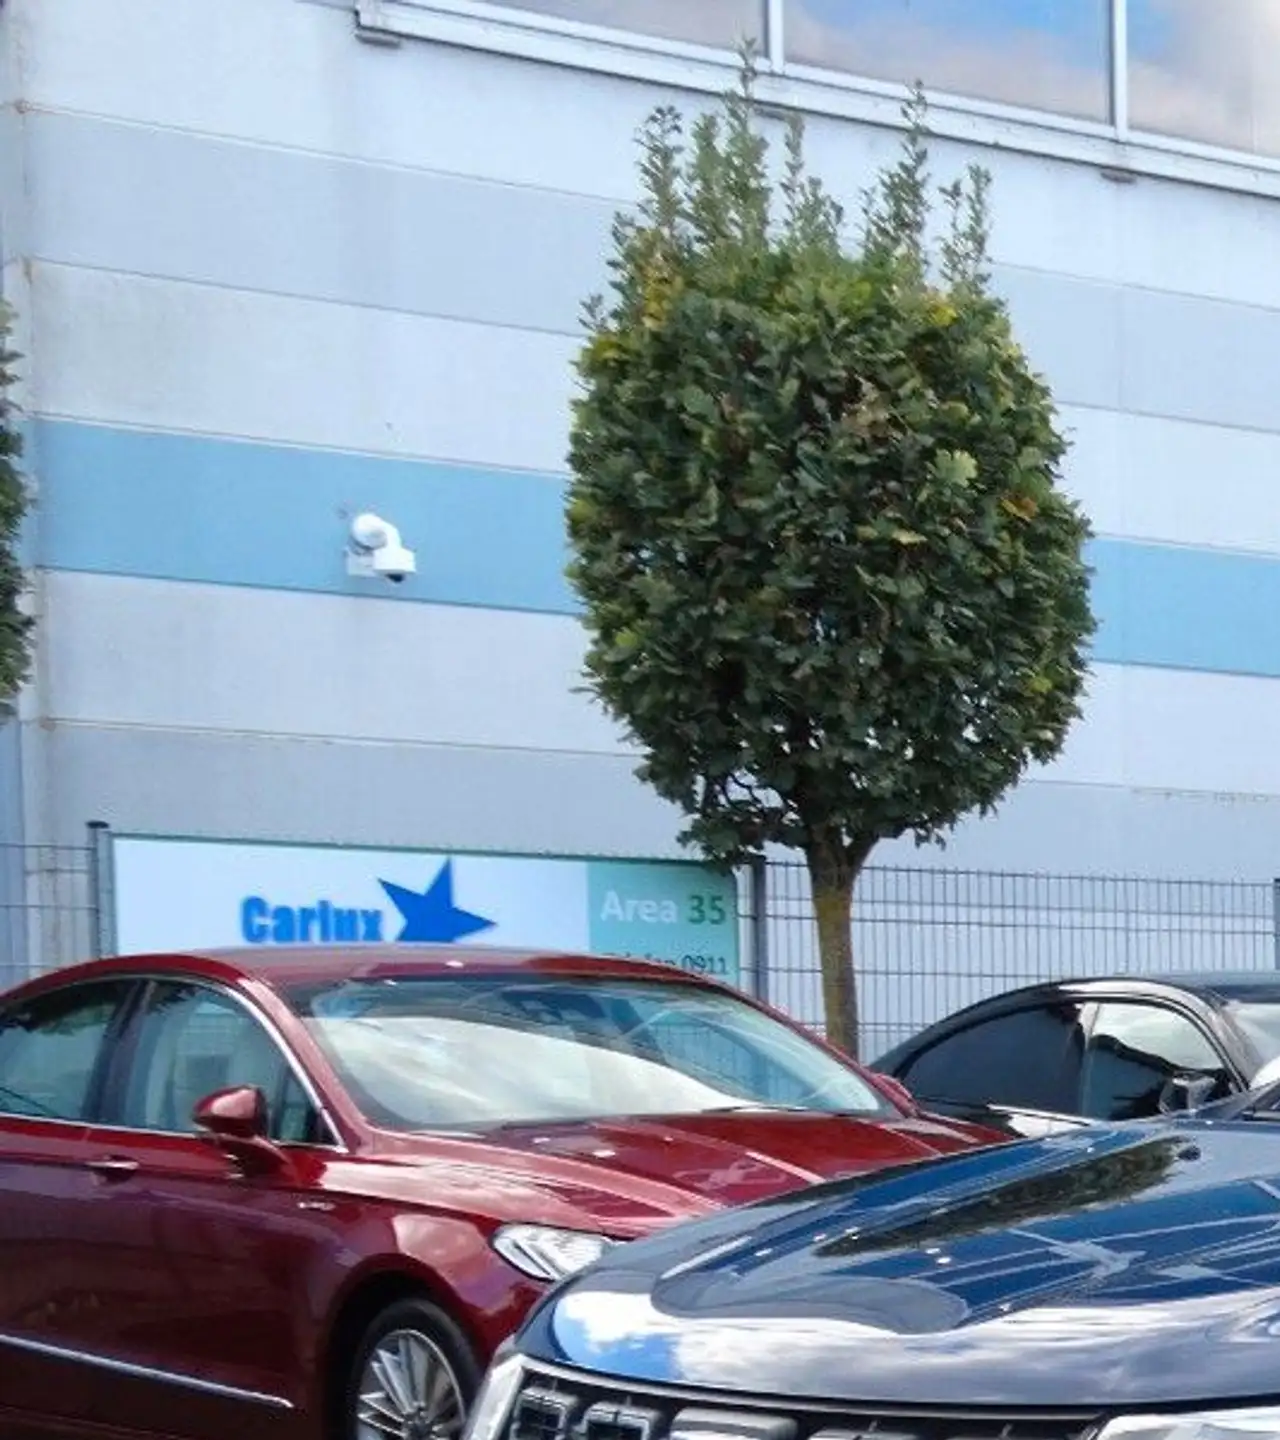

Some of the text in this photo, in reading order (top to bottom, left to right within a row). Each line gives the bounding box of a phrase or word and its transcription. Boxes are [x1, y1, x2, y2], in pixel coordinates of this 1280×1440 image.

[241, 896, 384, 943] Carlux
[600, 889, 726, 926] Area 35
